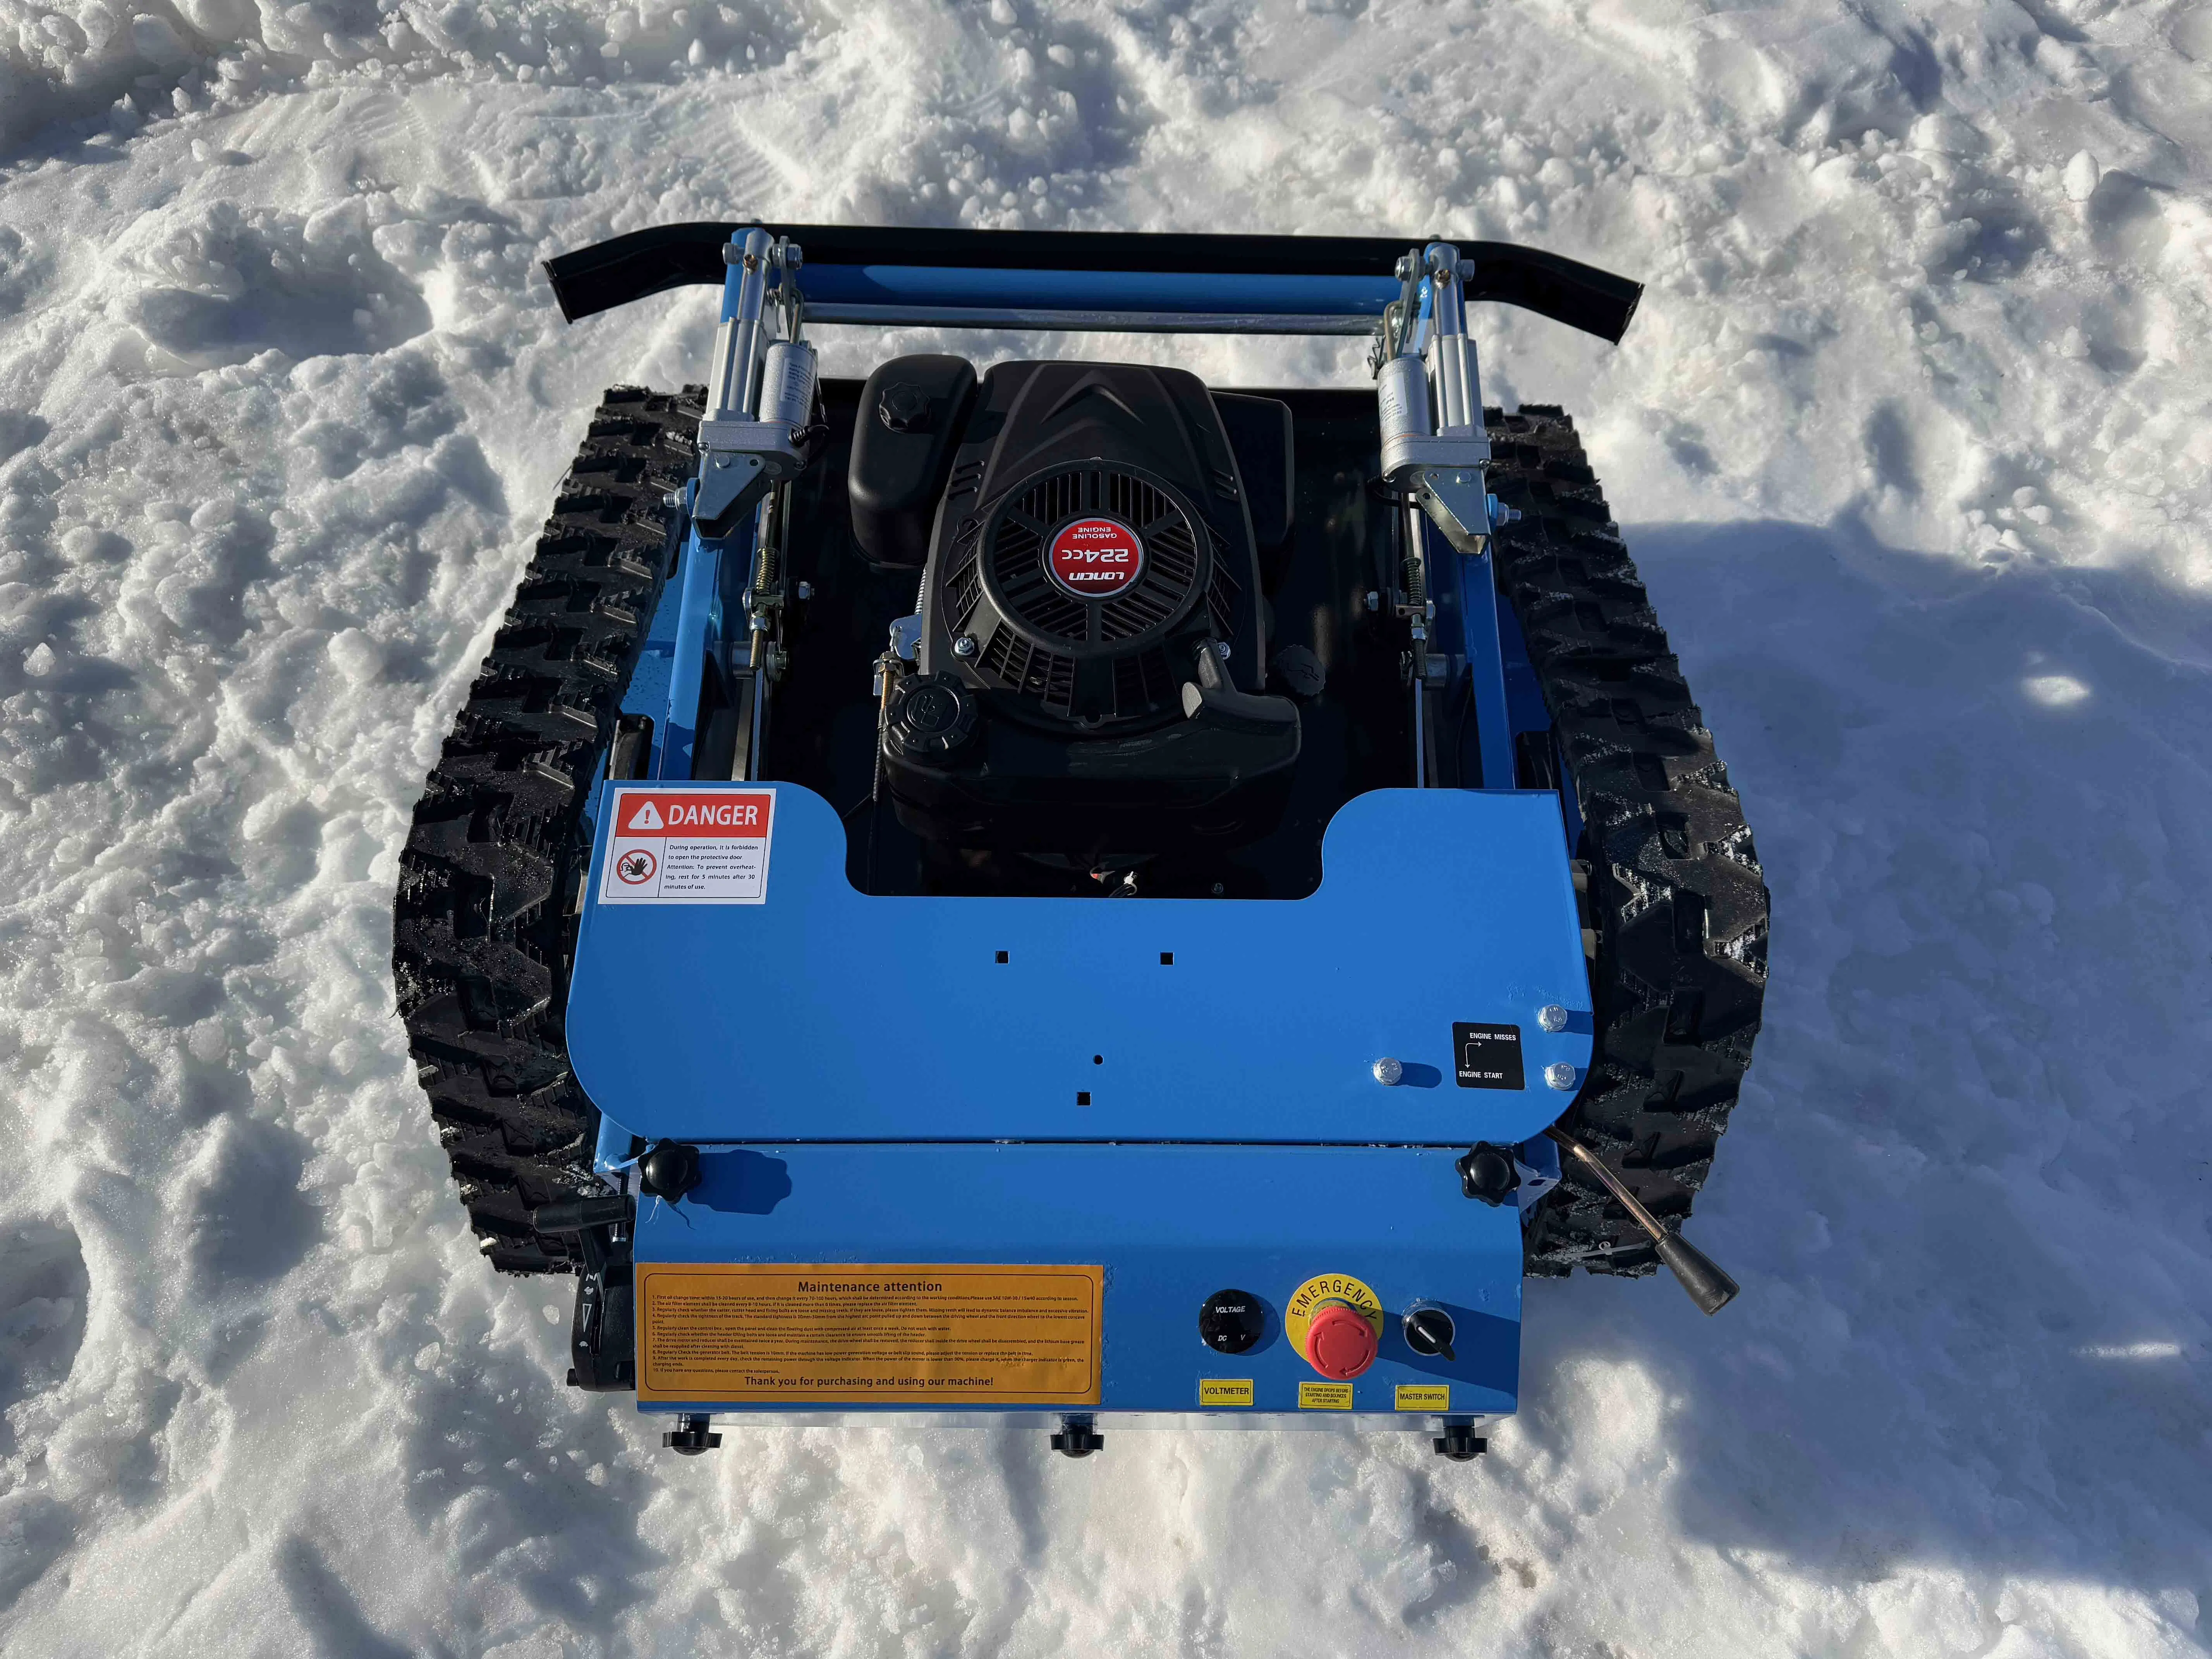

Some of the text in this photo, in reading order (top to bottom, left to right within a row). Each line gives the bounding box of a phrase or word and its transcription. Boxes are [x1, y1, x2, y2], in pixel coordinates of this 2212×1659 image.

[668, 805, 757, 825] DANGER
[799, 1281, 941, 1292] Maintenance attention
[1292, 1280, 1377, 1319] EMERGENCY
[744, 1376, 775, 1385] Thank
[778, 1379, 796, 1387] you
[800, 1377, 814, 1385] for
[817, 1377, 872, 1387] purchasing
[876, 1376, 894, 1385] and
[898, 1377, 924, 1387] using
[948, 1377, 993, 1386] machine!
